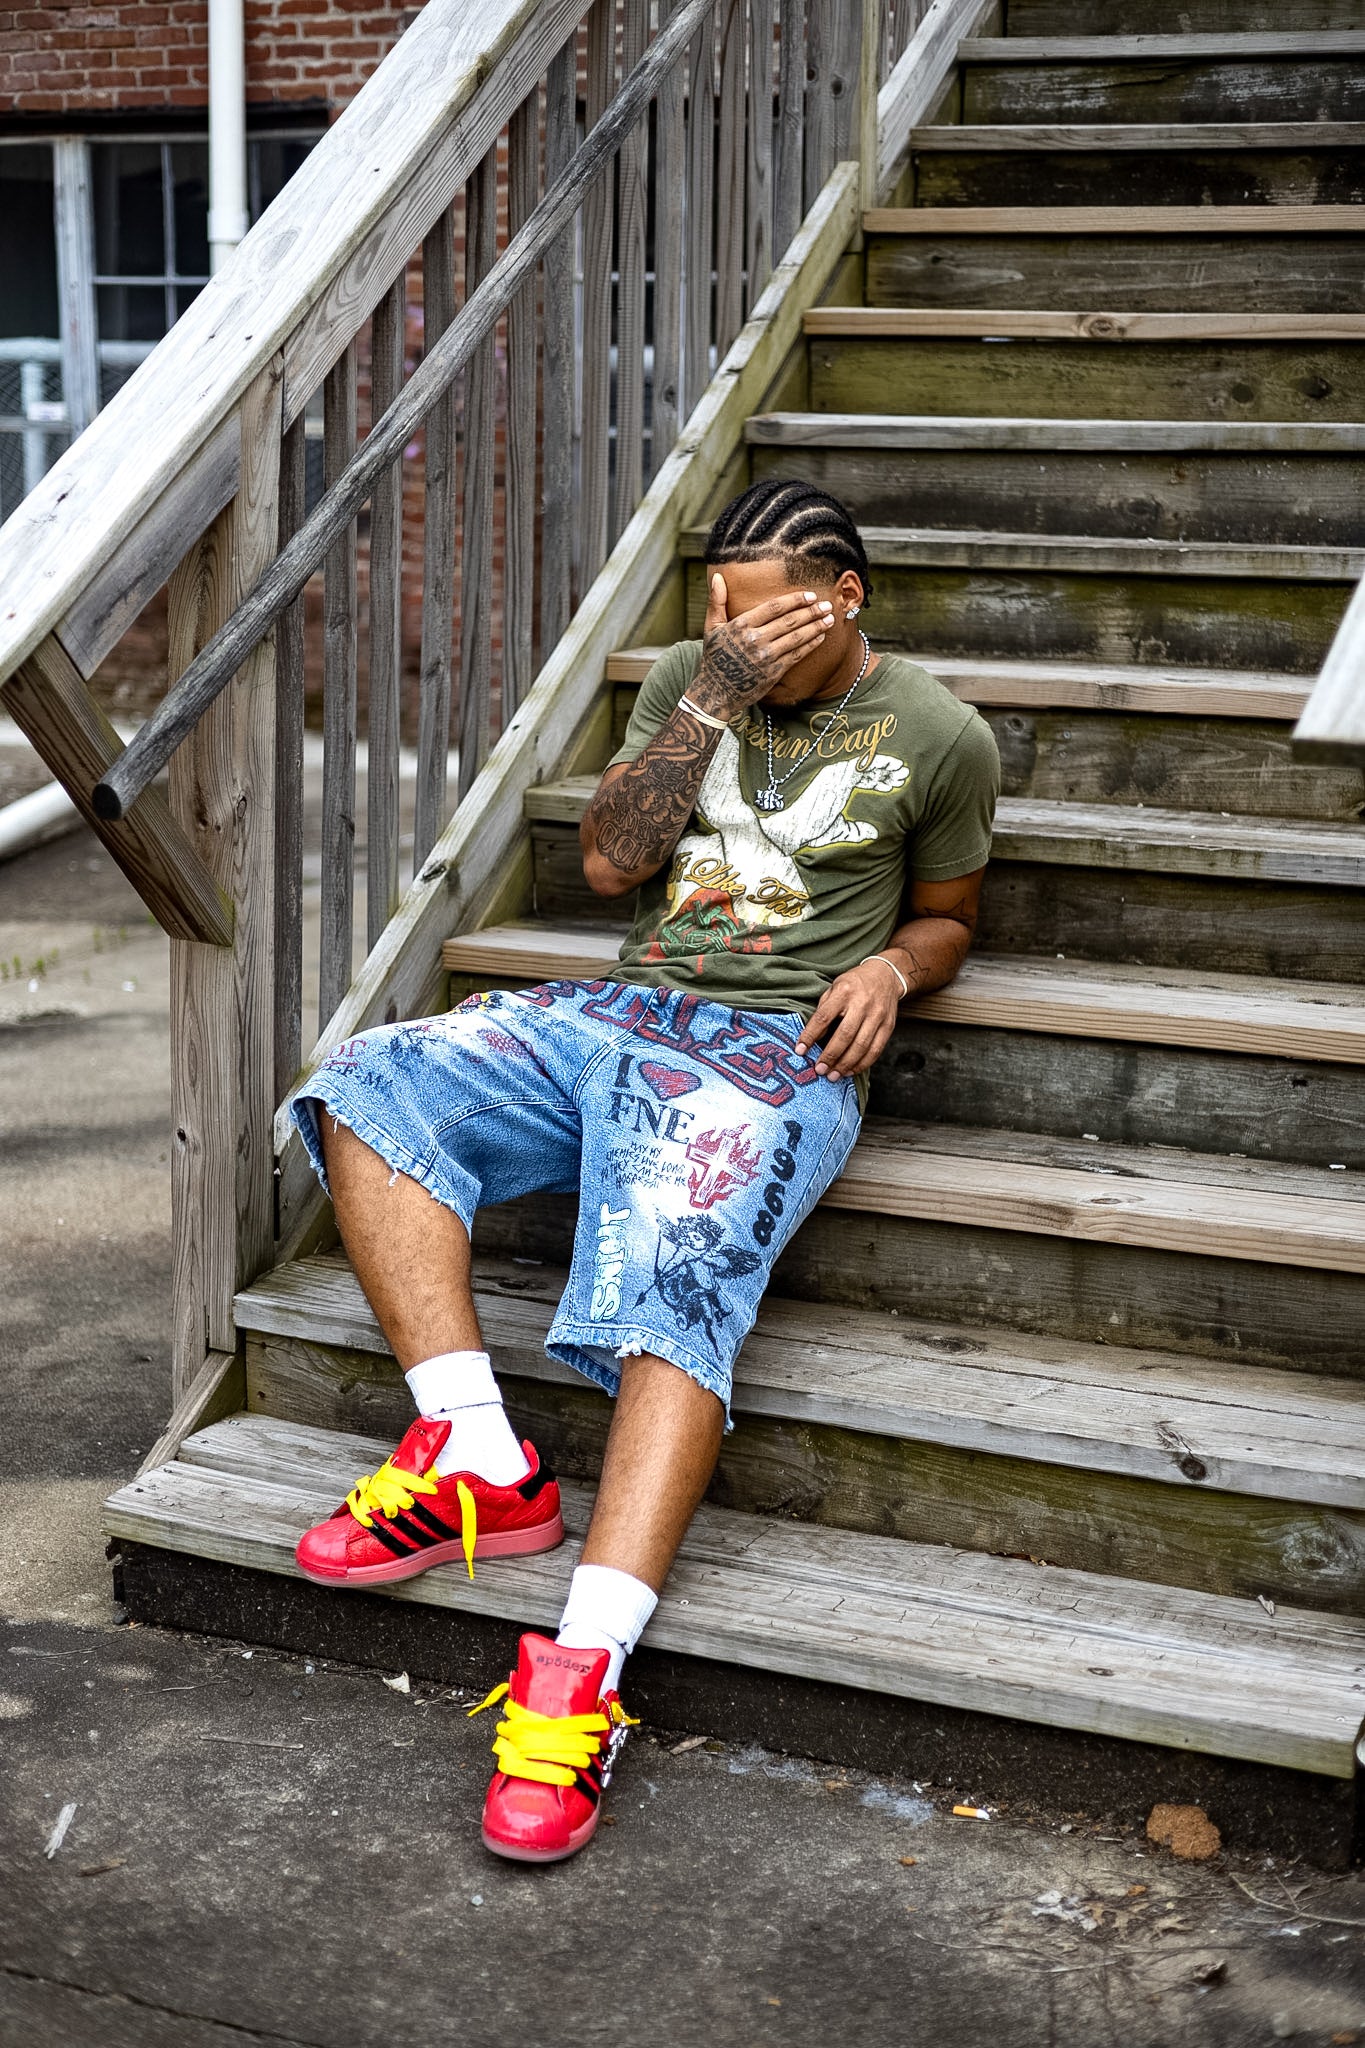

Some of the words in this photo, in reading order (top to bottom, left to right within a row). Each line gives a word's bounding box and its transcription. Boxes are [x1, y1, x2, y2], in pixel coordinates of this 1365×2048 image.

[809, 711, 897, 771] Cage
[683, 857, 747, 896] Like
[746, 877, 810, 918] This
[614, 1052, 635, 1088] I
[605, 1091, 695, 1145] FNE
[752, 1120, 804, 1247] 1968
